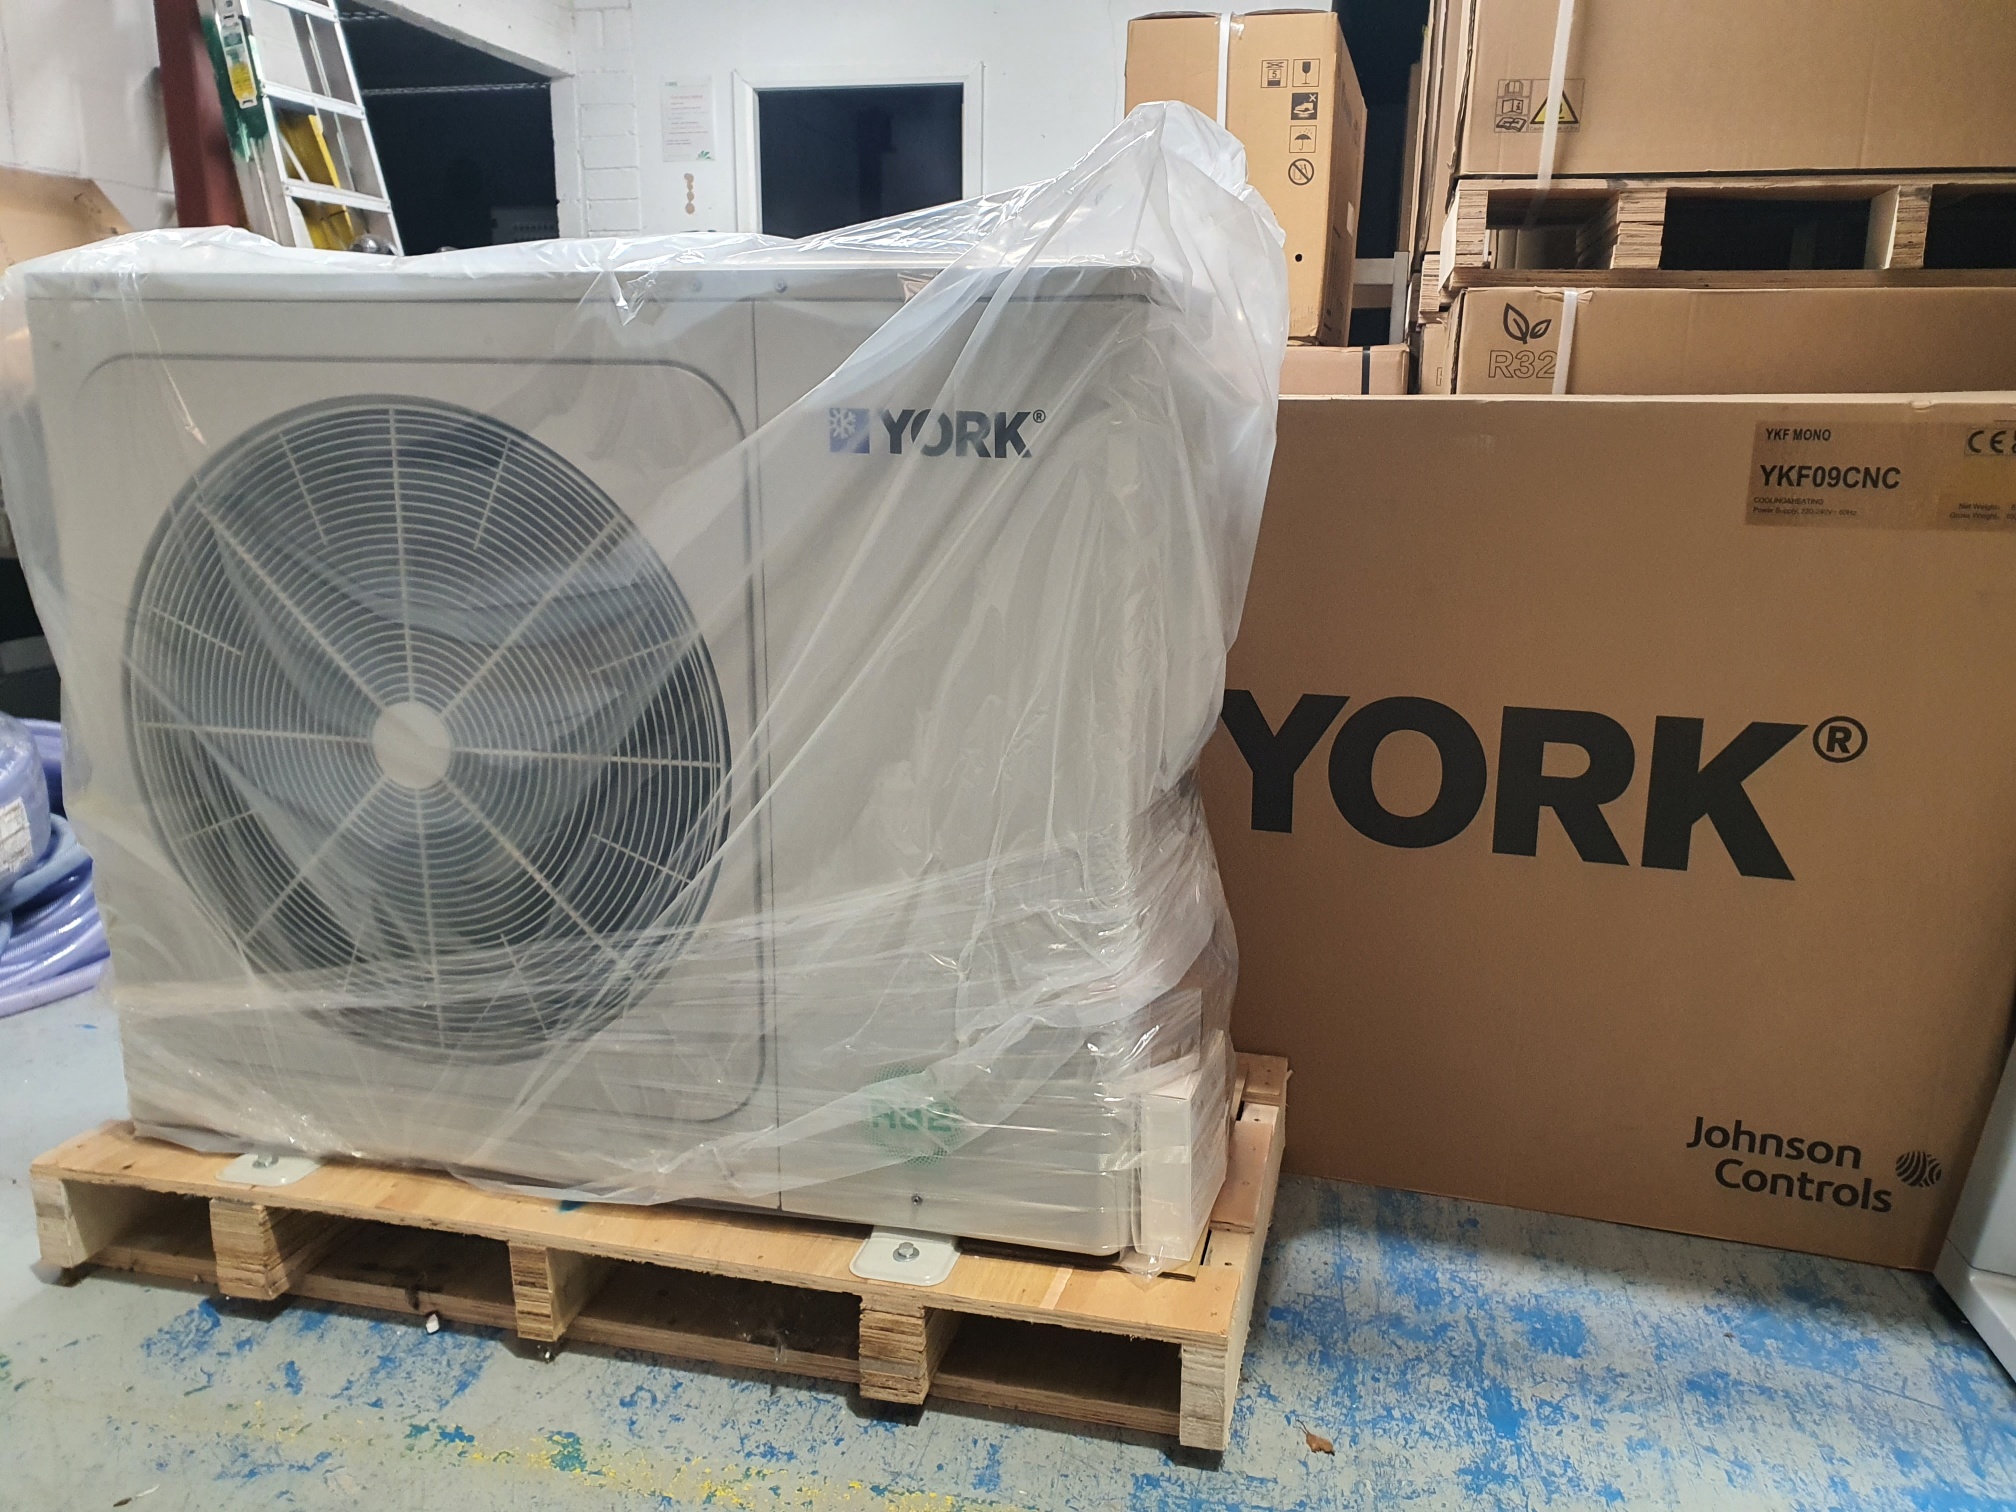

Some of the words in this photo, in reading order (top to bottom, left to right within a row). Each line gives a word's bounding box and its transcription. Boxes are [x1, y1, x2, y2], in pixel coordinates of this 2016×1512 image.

[1488, 349, 1558, 379] R32
[1765, 428, 1790, 441] YKF
[1793, 428, 1832, 442] MONO
[1759, 465, 1901, 490] YKF09CNC
[1686, 1116, 1862, 1169] Johnson
[1715, 1158, 1892, 1213] Controls
